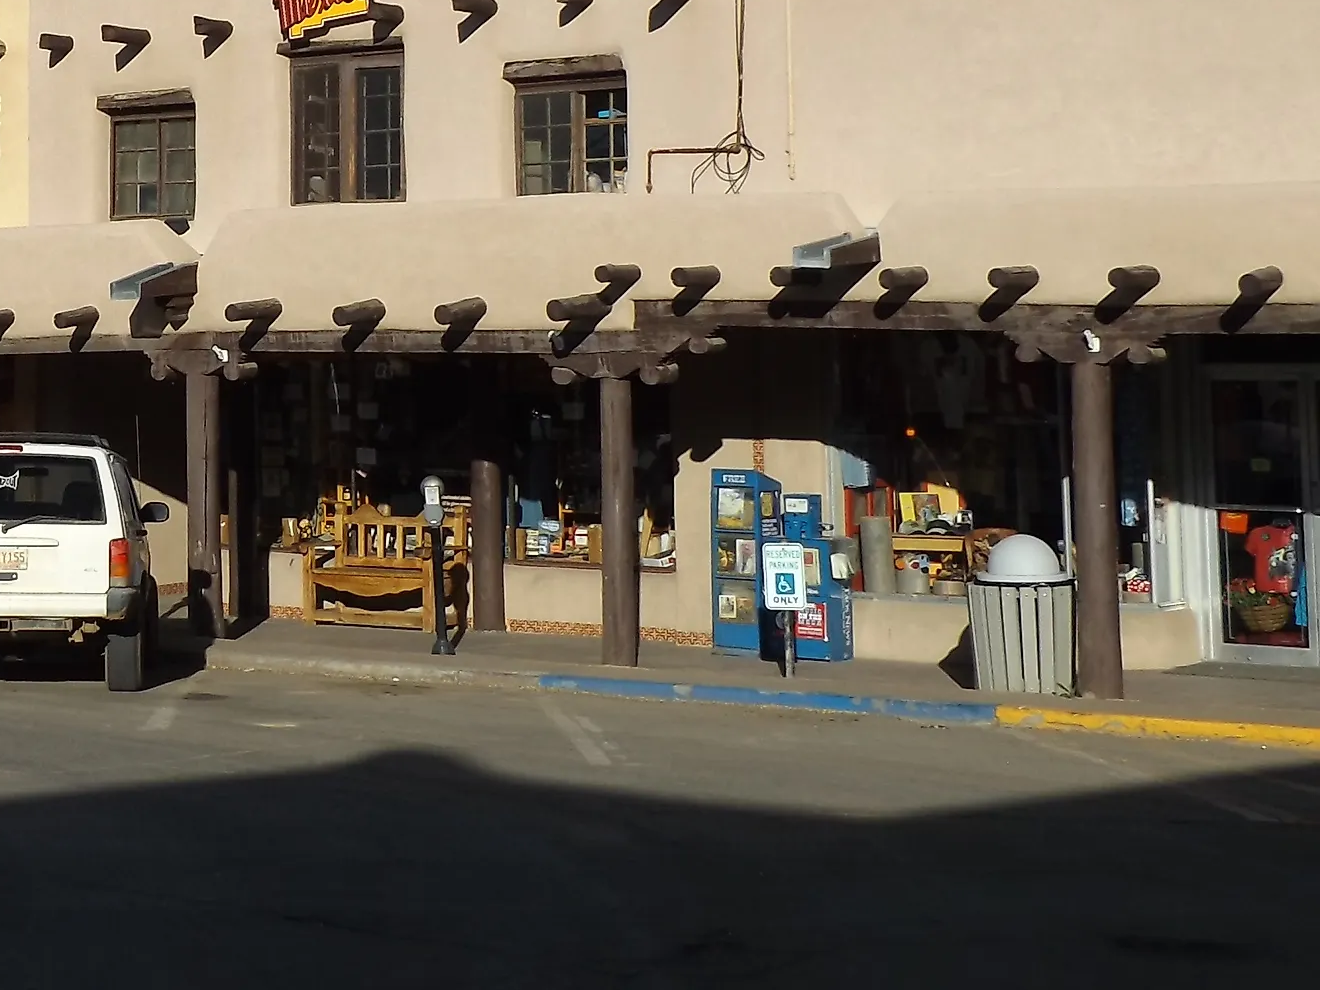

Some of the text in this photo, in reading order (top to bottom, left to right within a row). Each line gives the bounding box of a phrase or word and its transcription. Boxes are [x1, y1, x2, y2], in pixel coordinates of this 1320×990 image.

[766, 550, 801, 559] RESERVED
[768, 561, 799, 570] PARKING
[773, 596, 799, 606] ONLY
